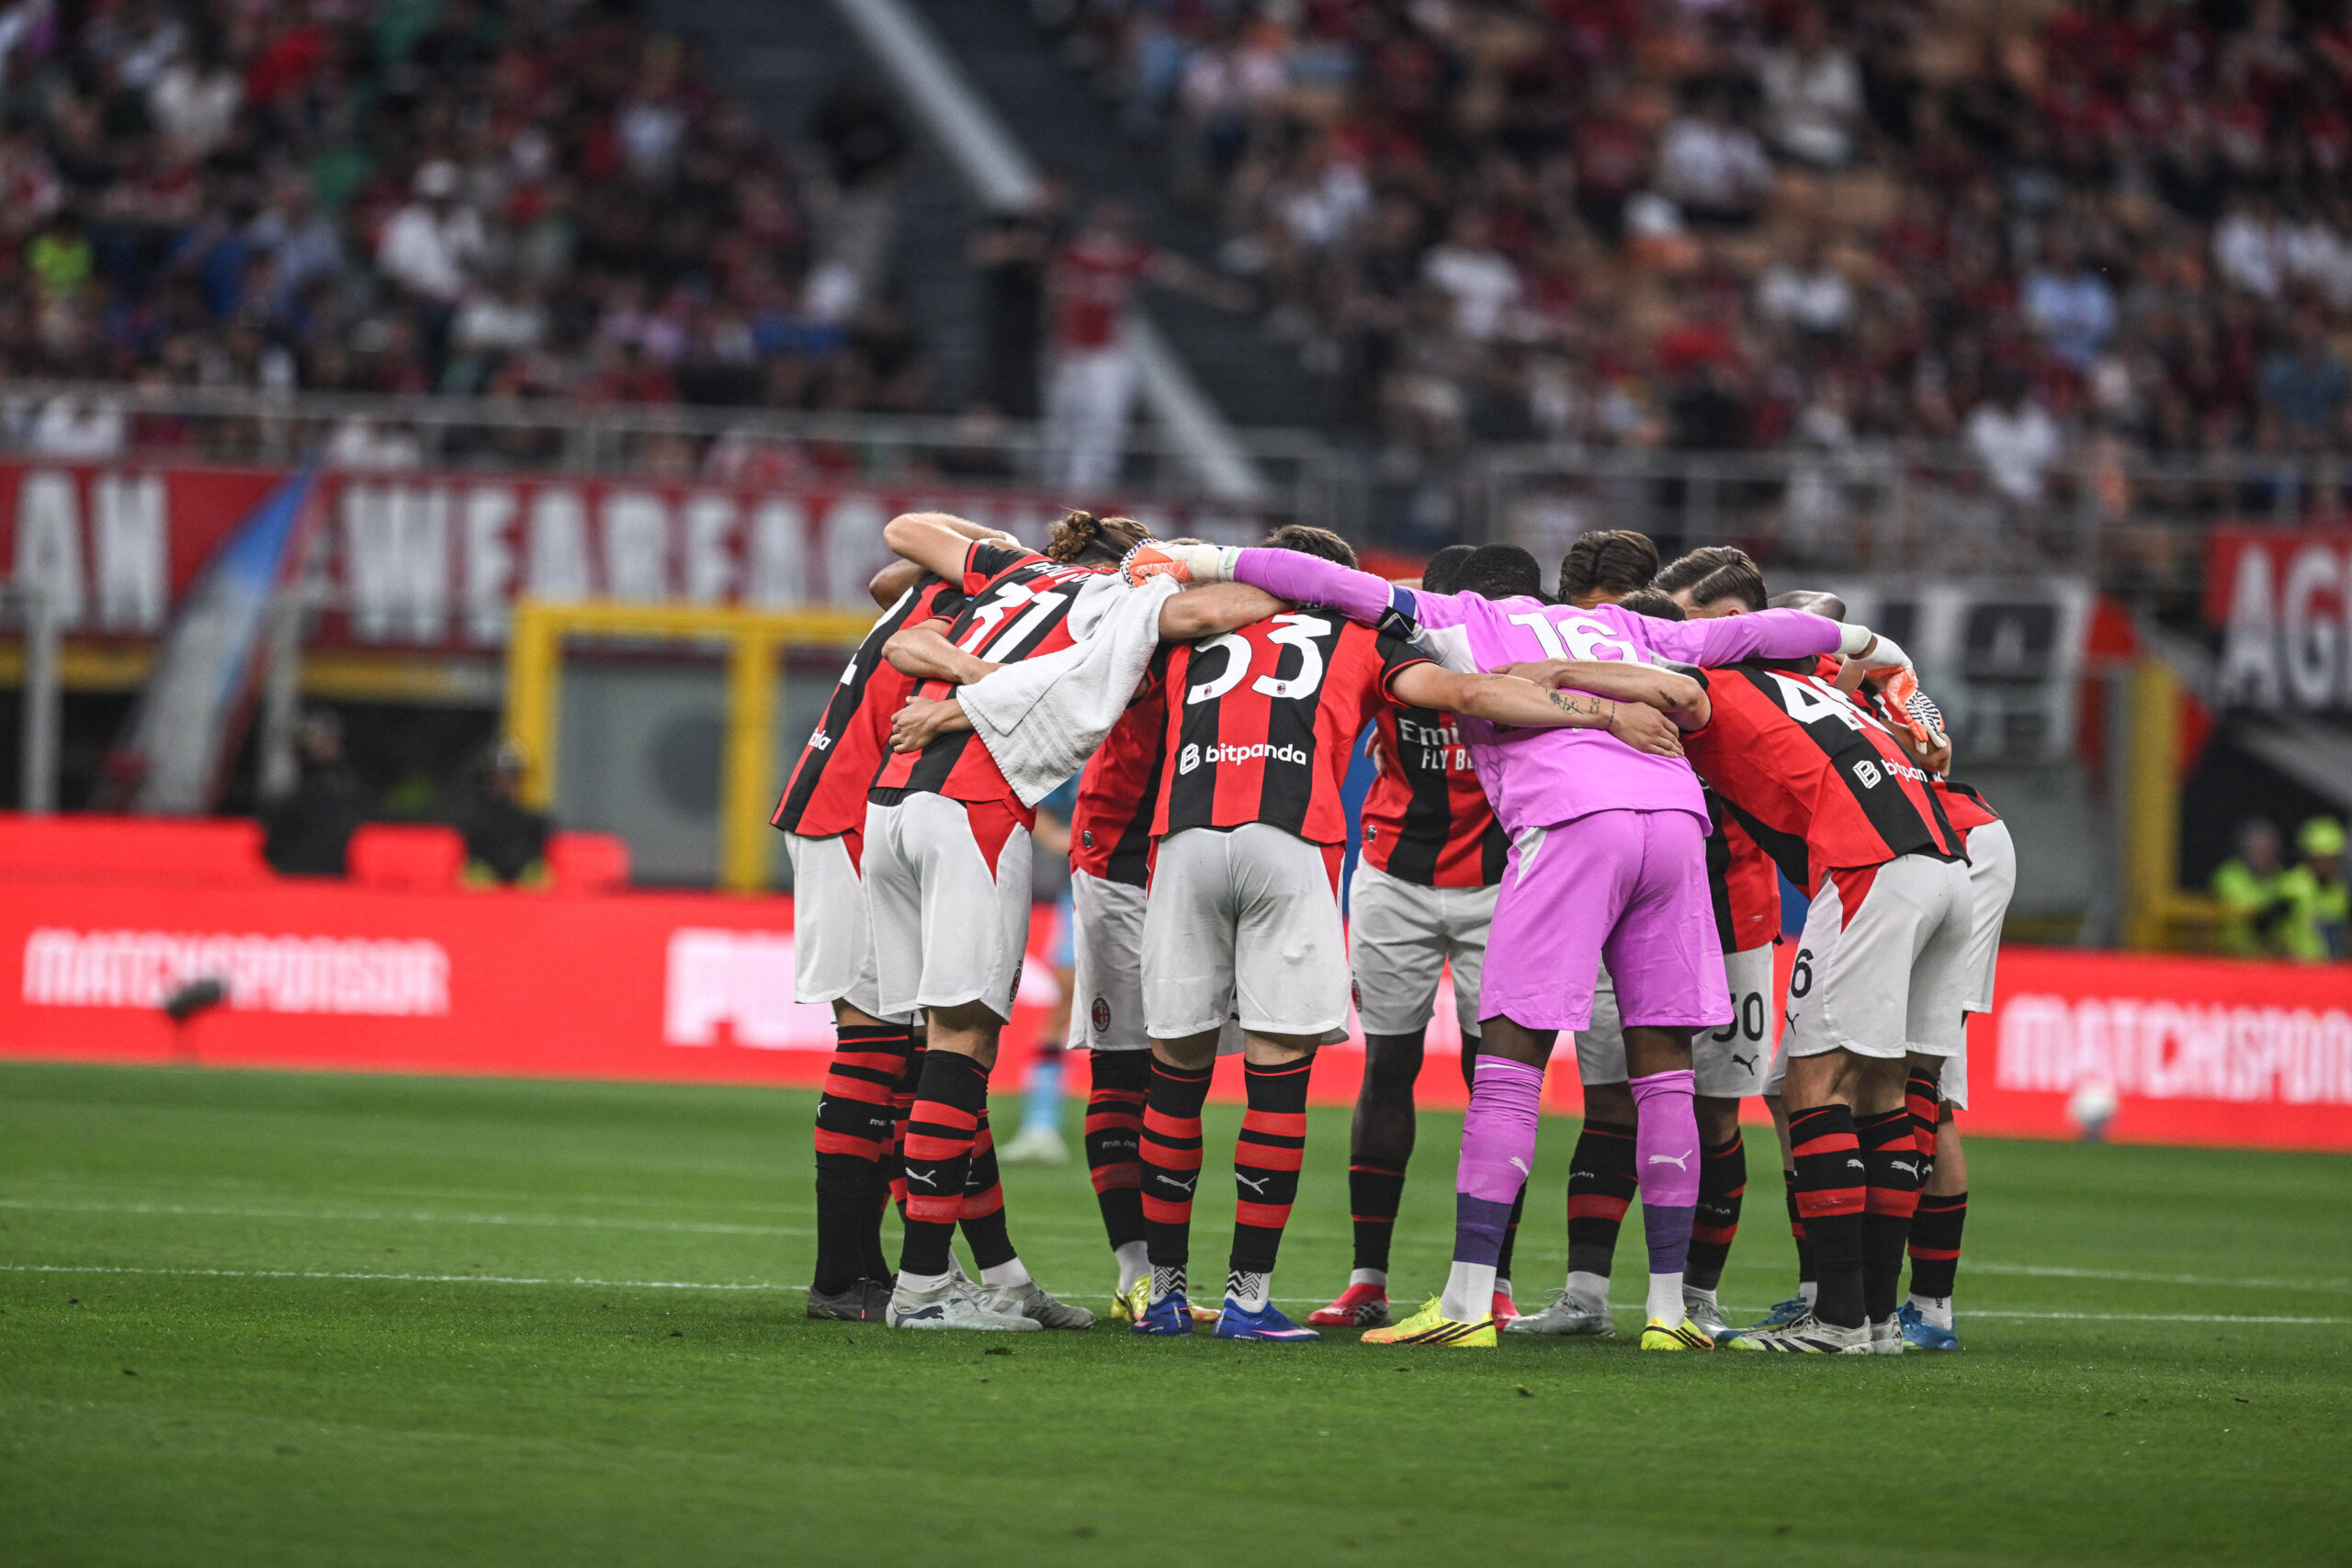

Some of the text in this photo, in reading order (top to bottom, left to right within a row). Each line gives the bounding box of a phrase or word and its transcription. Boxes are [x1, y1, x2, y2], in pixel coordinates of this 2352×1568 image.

[958, 581, 1069, 663] 31
[1507, 613, 1640, 662] 16
[2216, 542, 2352, 705] AG
[1187, 614, 1331, 705] 53
[1205, 743, 1306, 765] bitpanda
[1421, 747, 1450, 770] FLY
[1791, 948, 1815, 999] 6
